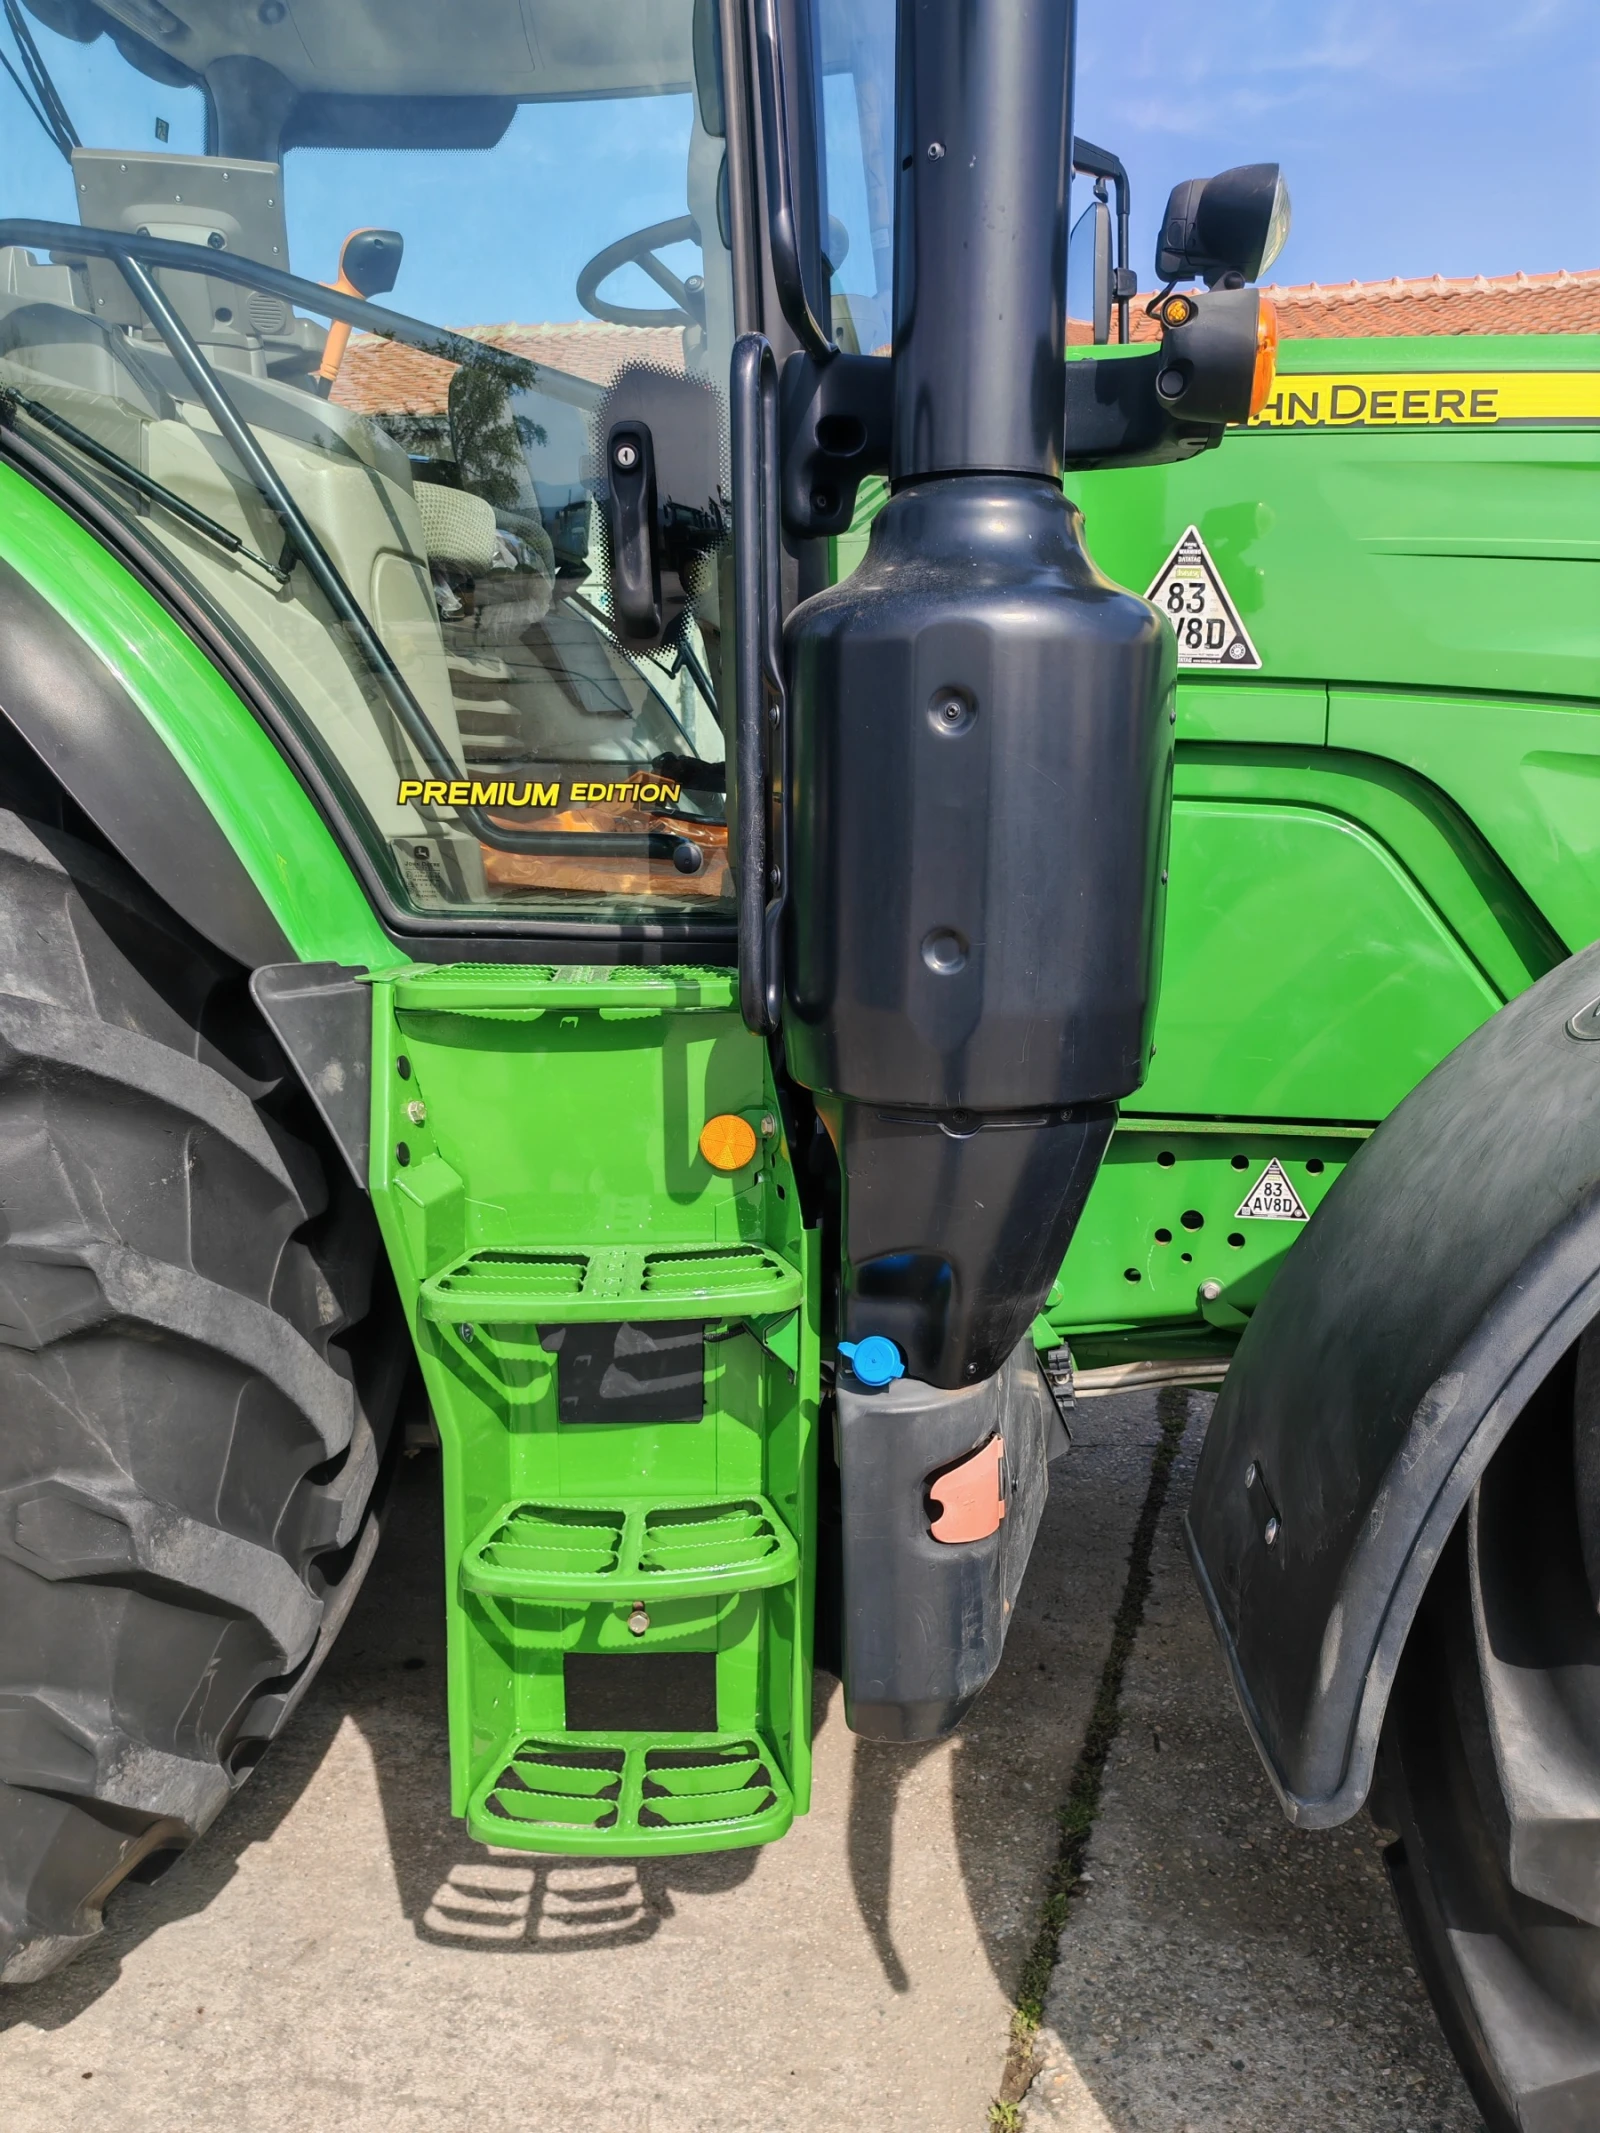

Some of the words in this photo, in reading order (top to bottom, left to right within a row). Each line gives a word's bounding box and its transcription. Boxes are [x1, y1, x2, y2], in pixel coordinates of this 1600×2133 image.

[1252, 391, 1319, 420] HN
[1330, 384, 1498, 419] DEERE
[1167, 582, 1206, 614] 83
[398, 780, 561, 806] PREMIUM
[569, 782, 681, 803] EDITION
[1264, 1182, 1282, 1197] 83
[1253, 1197, 1292, 1213] AV8D
